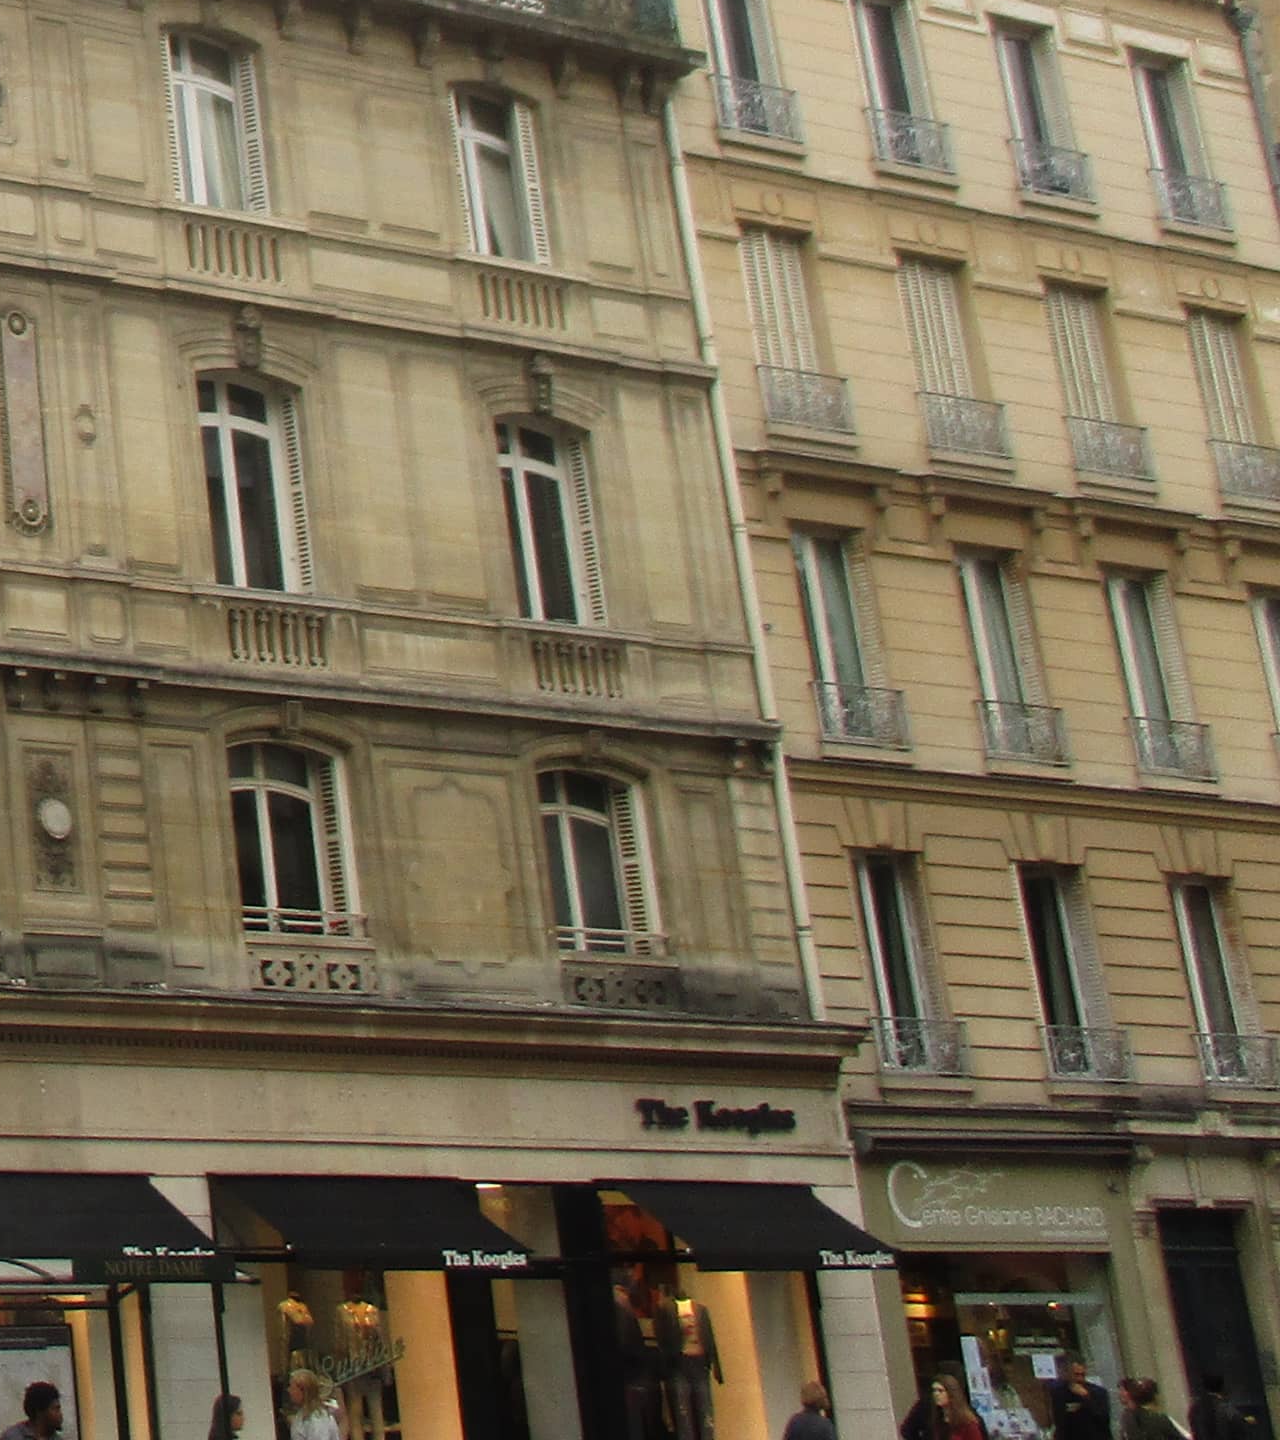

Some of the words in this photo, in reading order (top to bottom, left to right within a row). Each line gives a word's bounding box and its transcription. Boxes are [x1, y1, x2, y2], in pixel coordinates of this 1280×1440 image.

[634, 1098, 689, 1130] The
[442, 1249, 470, 1266] The
[472, 1249, 527, 1270] Kooples
[819, 1250, 844, 1265] The
[845, 1250, 896, 1268] Kooples
